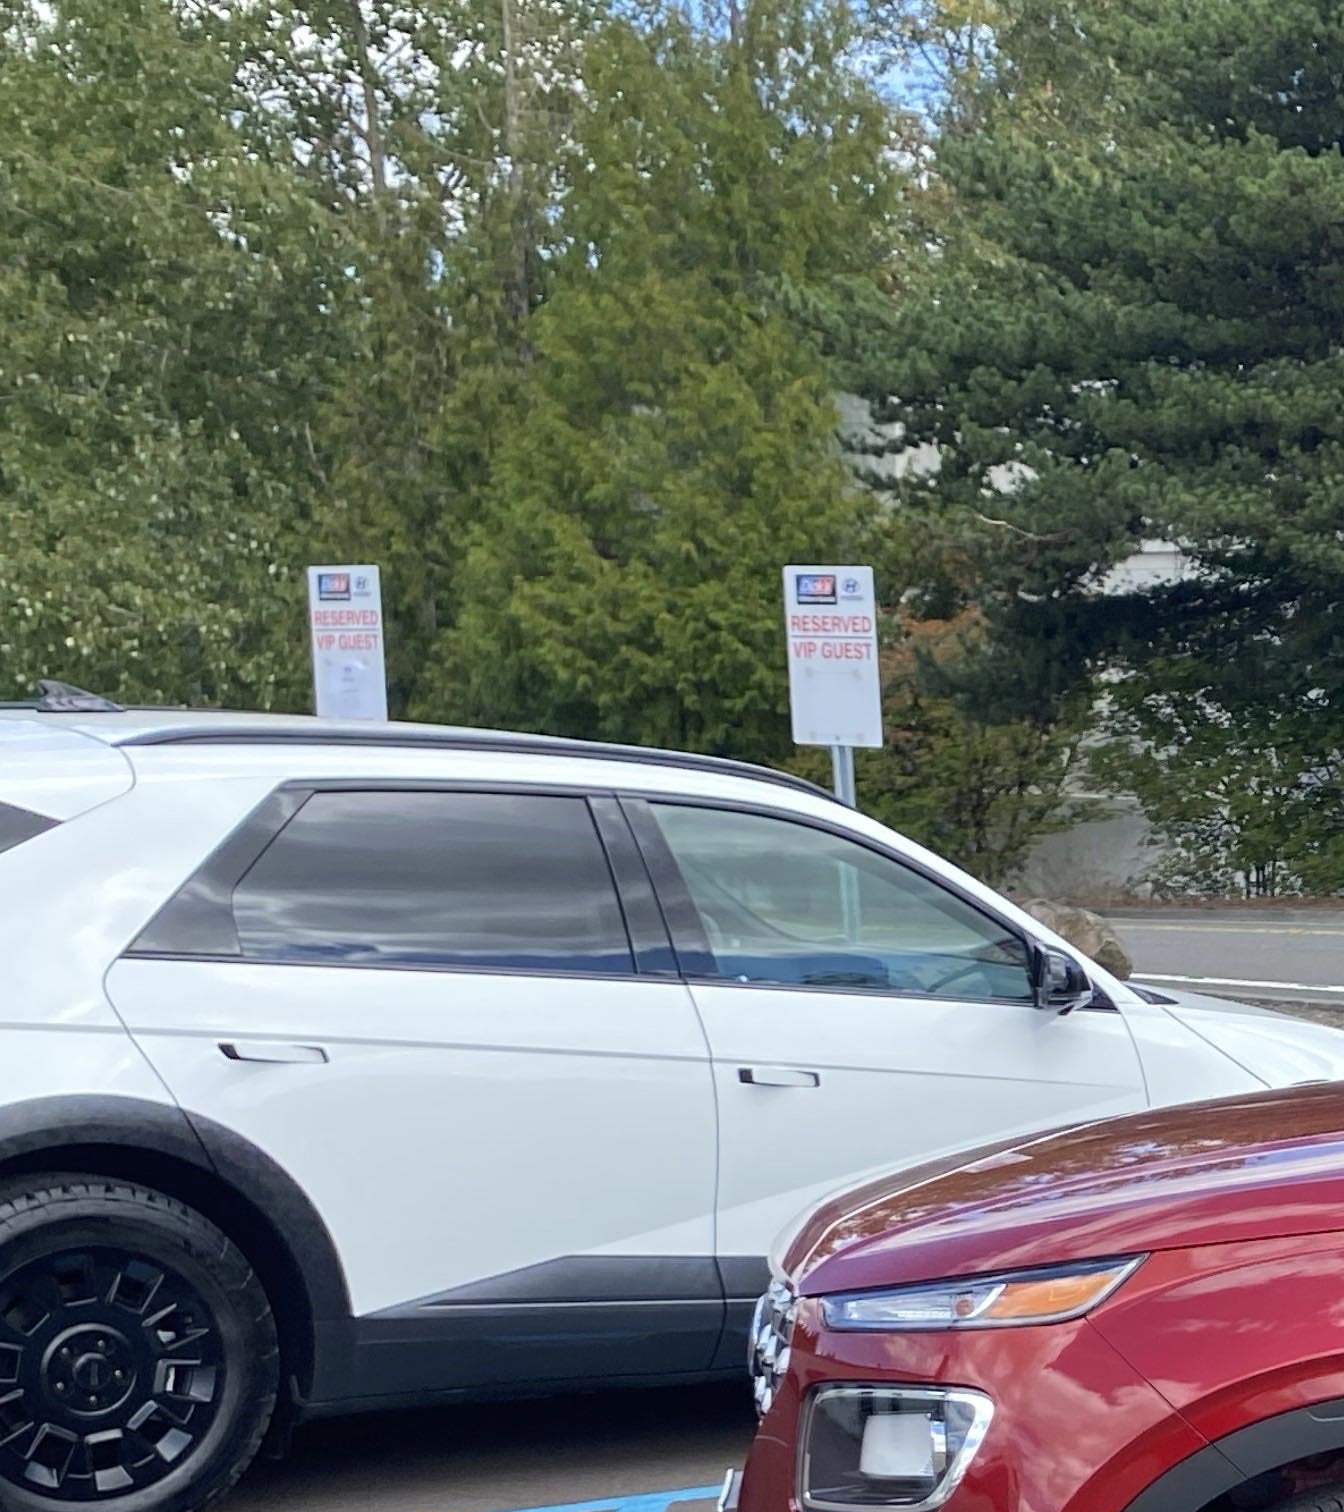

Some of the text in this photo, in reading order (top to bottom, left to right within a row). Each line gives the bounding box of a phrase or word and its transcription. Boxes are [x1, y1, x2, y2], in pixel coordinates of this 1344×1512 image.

[315, 611, 378, 625] RESERVED
[791, 616, 872, 633] RESERVED
[317, 634, 378, 650] VIP GUEST
[793, 642, 872, 659] VIP GUEST
